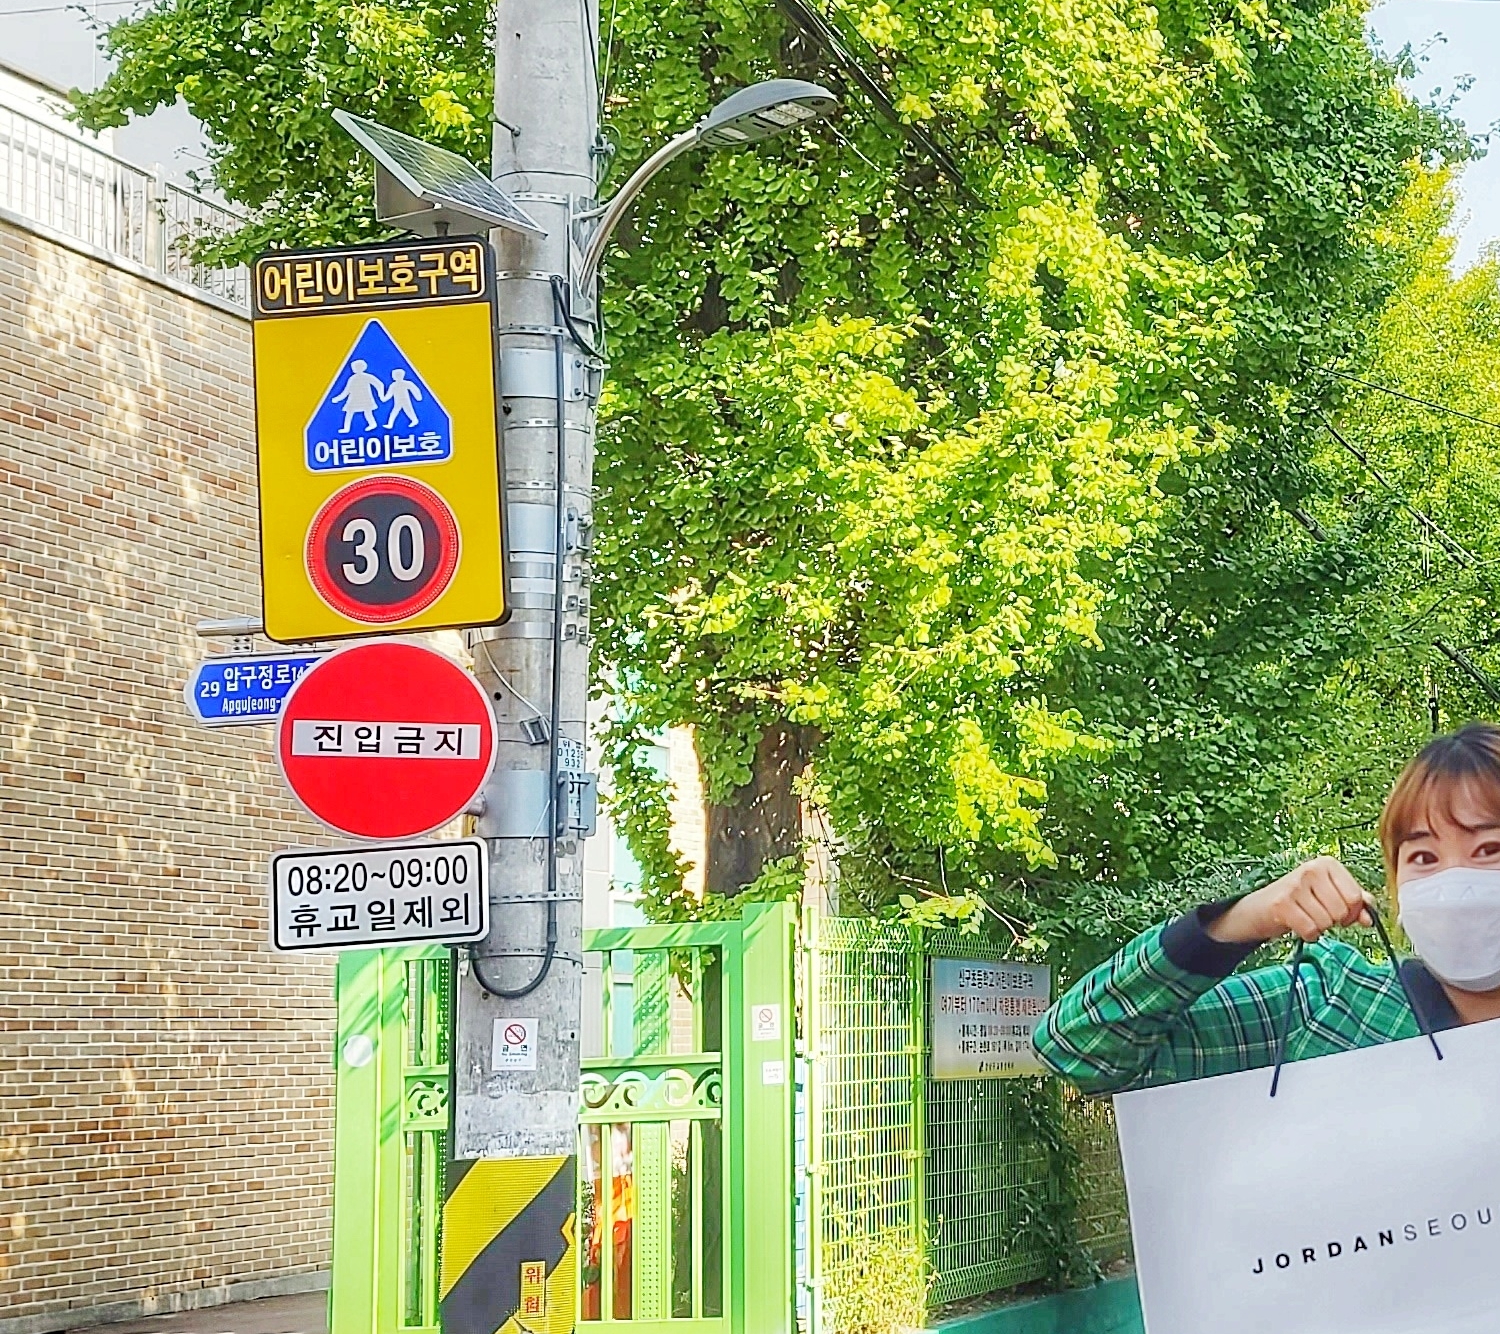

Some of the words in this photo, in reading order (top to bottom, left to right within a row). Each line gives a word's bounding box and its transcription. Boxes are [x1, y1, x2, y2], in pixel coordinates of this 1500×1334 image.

[263, 248, 478, 306] 어린이보호구역
[314, 431, 444, 466] 어린이보호
[342, 514, 425, 585] 30
[200, 681, 220, 698] 29
[223, 662, 315, 692] 압구정로14
[312, 724, 464, 756] 진입금지
[287, 854, 469, 897] 08:20~09:00
[287, 892, 470, 938] 휴교일제외
